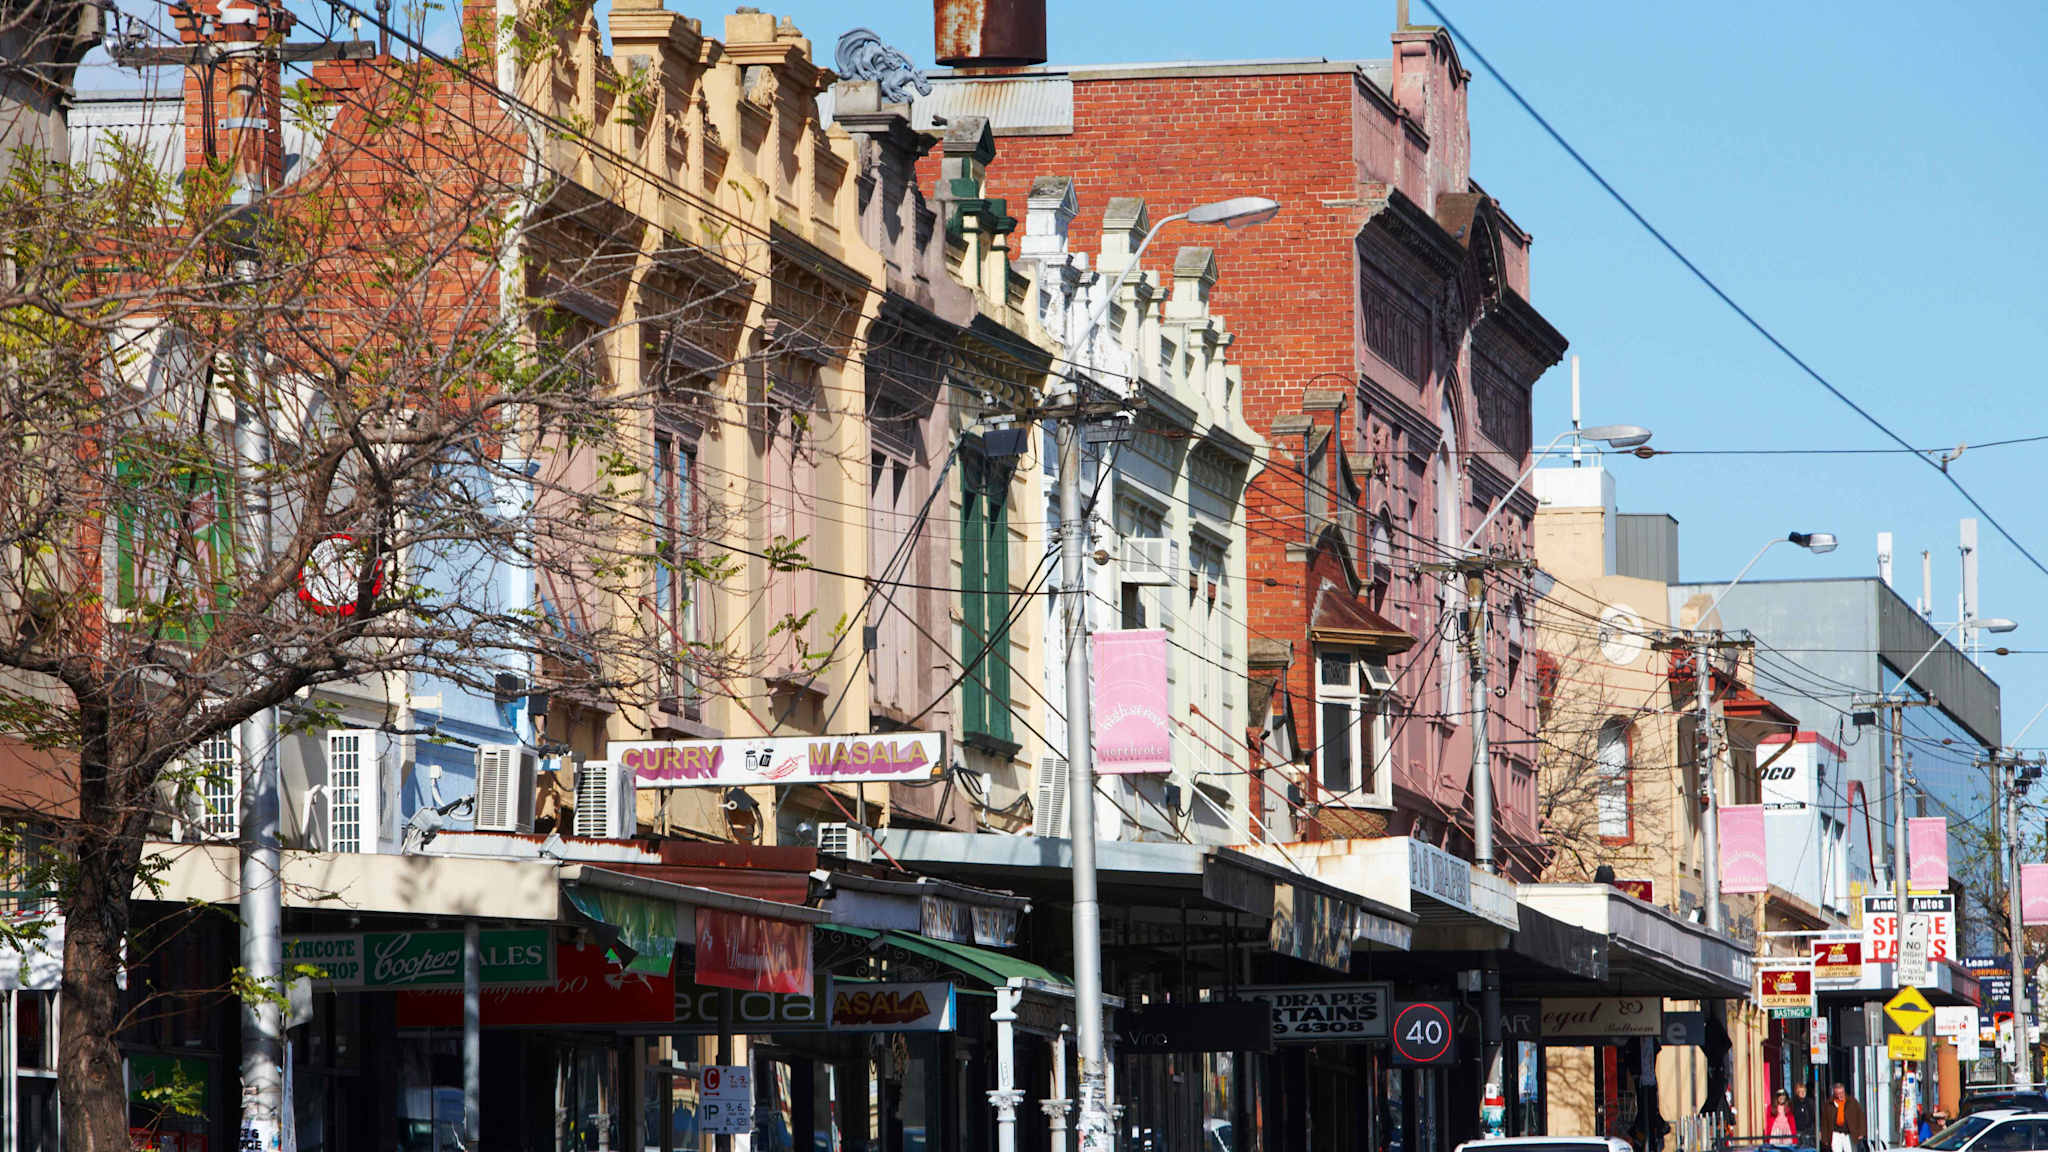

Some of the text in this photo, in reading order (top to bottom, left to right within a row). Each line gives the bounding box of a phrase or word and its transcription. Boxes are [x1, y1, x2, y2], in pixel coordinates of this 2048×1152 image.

[622, 741, 928, 778] CURRY MASALA
[1913, 898, 1944, 909] Autos
[1873, 917, 1946, 935] SPE
[1873, 939, 1946, 958] PAS
[1907, 942, 1921, 950] NO
[375, 931, 461, 980] Coopers
[834, 991, 930, 1022] ASALA
[1277, 992, 1377, 1007] DRAPES
[1272, 1006, 1378, 1023] RTAINS
[1542, 1002, 1602, 1029] egal
[1295, 1021, 1364, 1033] 4308
[1405, 1020, 1442, 1045] 40
[704, 1104, 719, 1121] 1P
